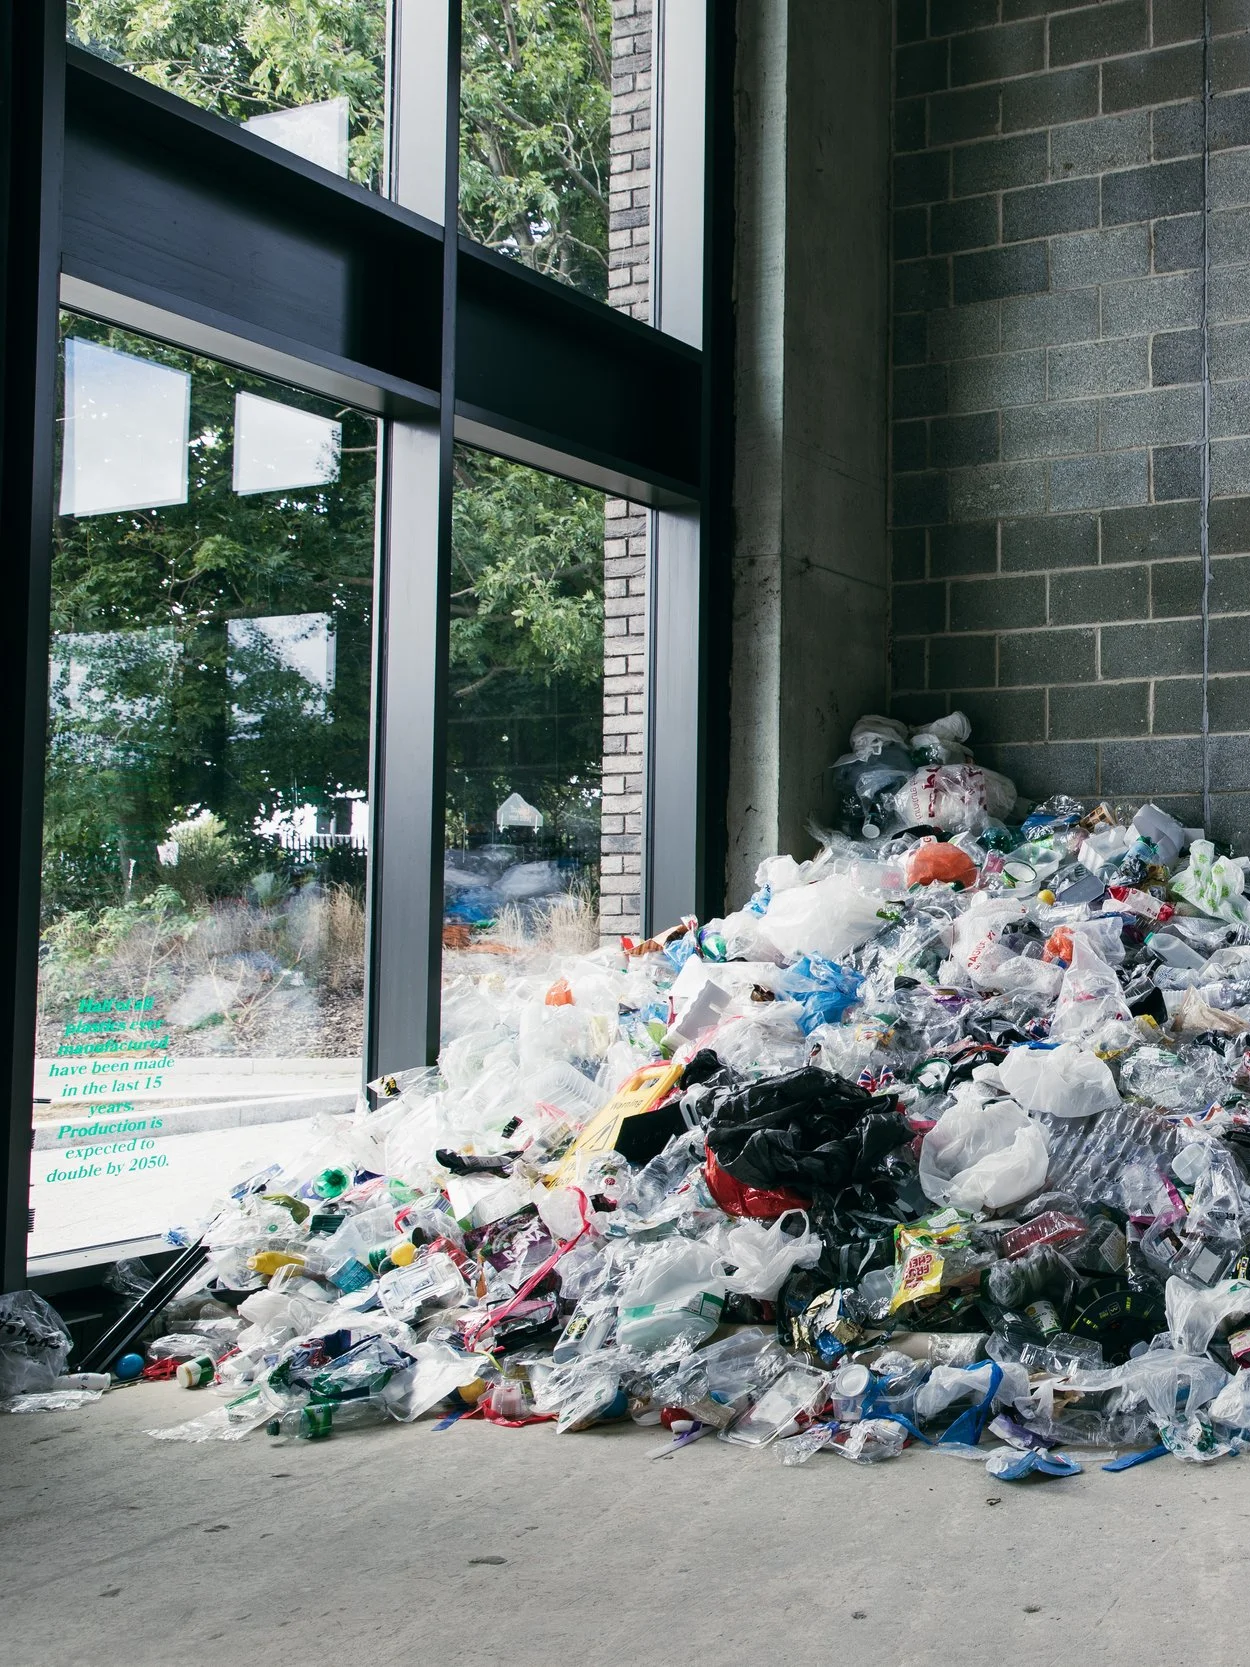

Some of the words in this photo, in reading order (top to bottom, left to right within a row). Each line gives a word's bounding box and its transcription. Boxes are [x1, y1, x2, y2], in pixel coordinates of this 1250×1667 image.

[78, 997, 116, 1014] Half
[115, 997, 135, 1012] of
[134, 996, 155, 1012] all
[64, 1017, 126, 1037] plastics
[129, 1019, 165, 1031] ever
[57, 1035, 170, 1056] manufactured
[48, 1064, 88, 1077] have
[91, 1061, 130, 1074] been
[133, 1056, 175, 1071] made
[61, 1083, 78, 1097] in
[82, 1081, 108, 1096] the
[111, 1079, 140, 1093] last
[144, 1076, 164, 1090] 15
[88, 1101, 135, 1118] years.
[57, 1119, 147, 1139] Production
[150, 1116, 164, 1129] is
[65, 1137, 138, 1160] expected
[140, 1139, 155, 1150] to
[46, 1164, 102, 1183] double
[105, 1161, 125, 1177] by
[128, 1154, 169, 1172] 2050.
